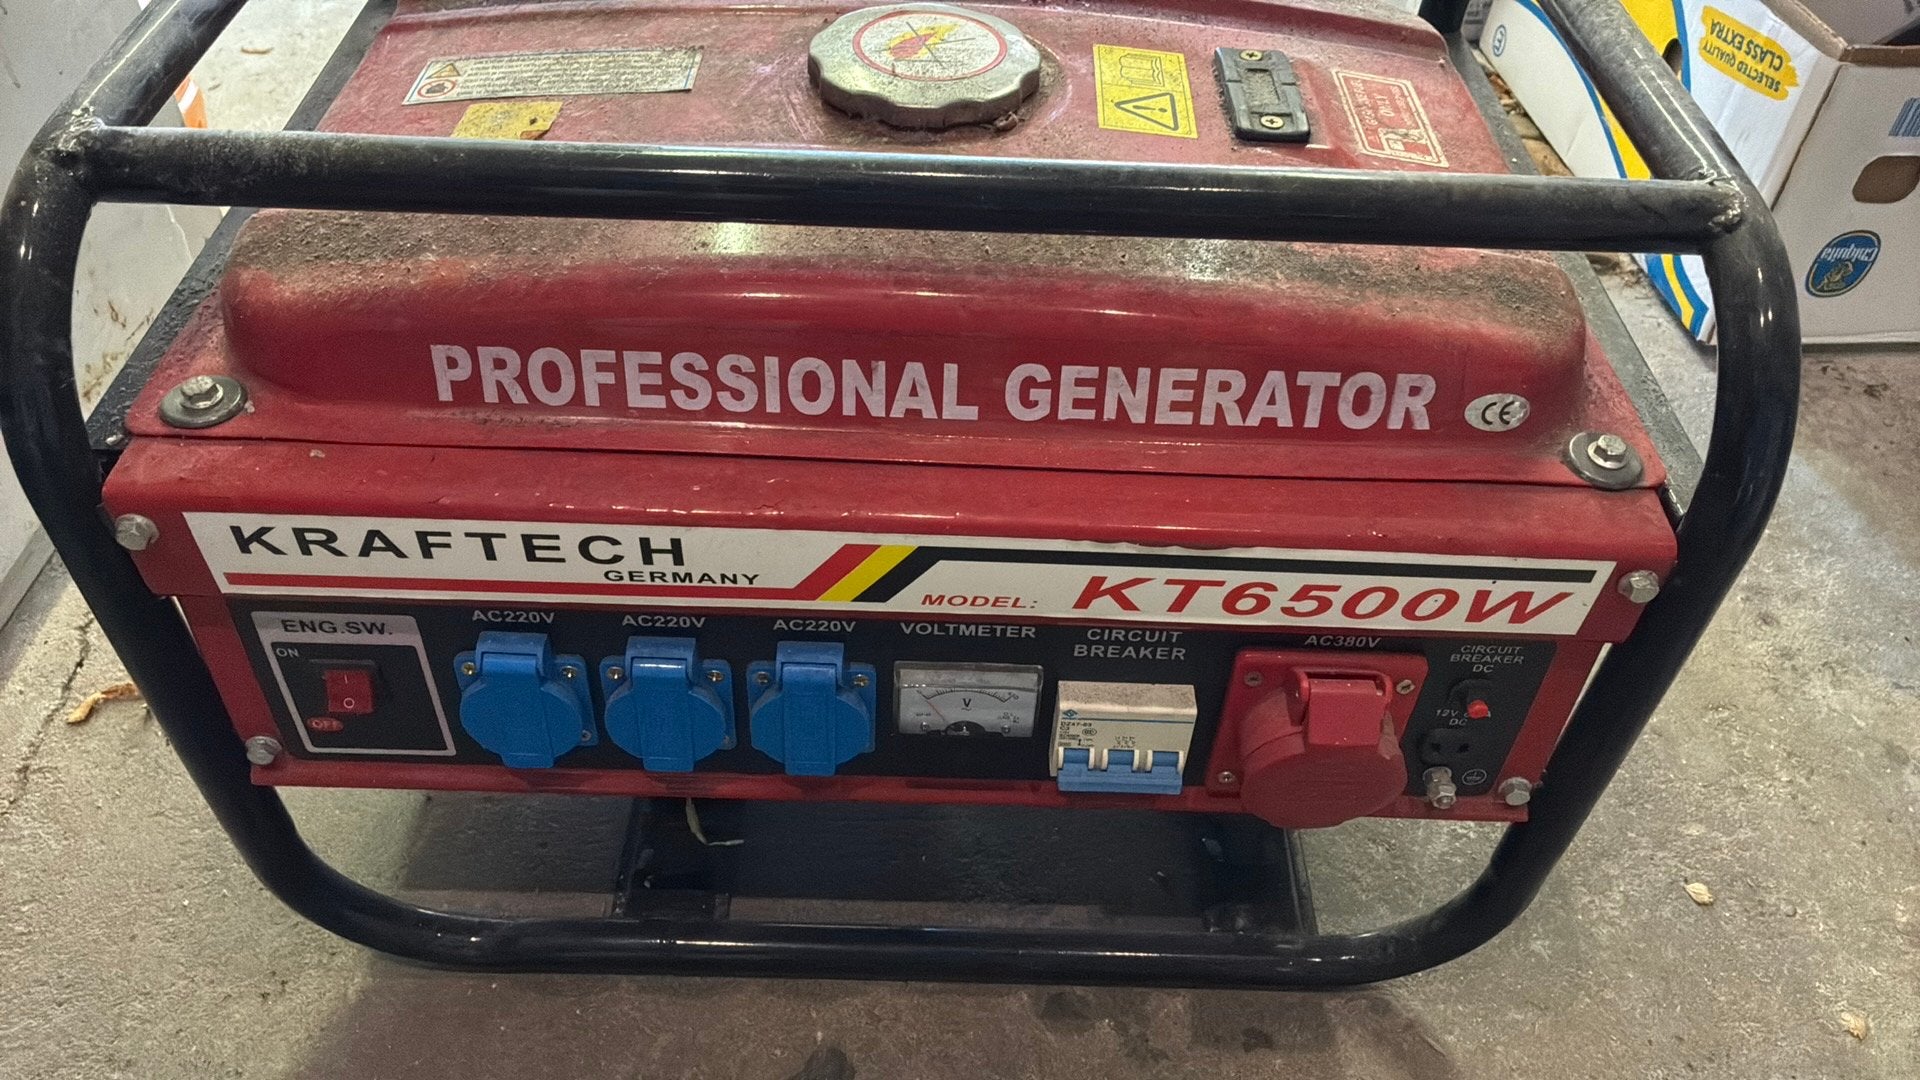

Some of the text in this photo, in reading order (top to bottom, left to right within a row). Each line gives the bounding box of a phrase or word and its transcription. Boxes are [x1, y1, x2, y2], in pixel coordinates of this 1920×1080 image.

[1709, 19, 1784, 72] CLASS EXTRA
[1703, 40, 1781, 93] SELECTED QUALITY
[430, 344, 1437, 430] PROFESSIONAL GENERATOR
[1481, 401, 1515, 426] CE
[229, 525, 685, 566] KRAFTECH
[603, 570, 760, 586] GERMANY
[920, 575, 1575, 625] MODEL: KT6500W
[471, 610, 555, 625] AC220V
[621, 614, 706, 629] AC220V
[280, 619, 393, 636] ENG.SW.
[773, 619, 857, 633] AC220V
[900, 622, 1037, 639] VOLTMETER
[1087, 628, 1183, 643] CIRCUIT
[1304, 635, 1381, 649] AC380V
[276, 647, 299, 658] ON
[1073, 644, 1186, 661] BREAKER
[1460, 644, 1523, 655] CIRCUIT
[1450, 653, 1525, 665] BREAKER
[1472, 664, 1494, 674] DC
[962, 698, 972, 708] V
[1449, 718, 1468, 727] DC
